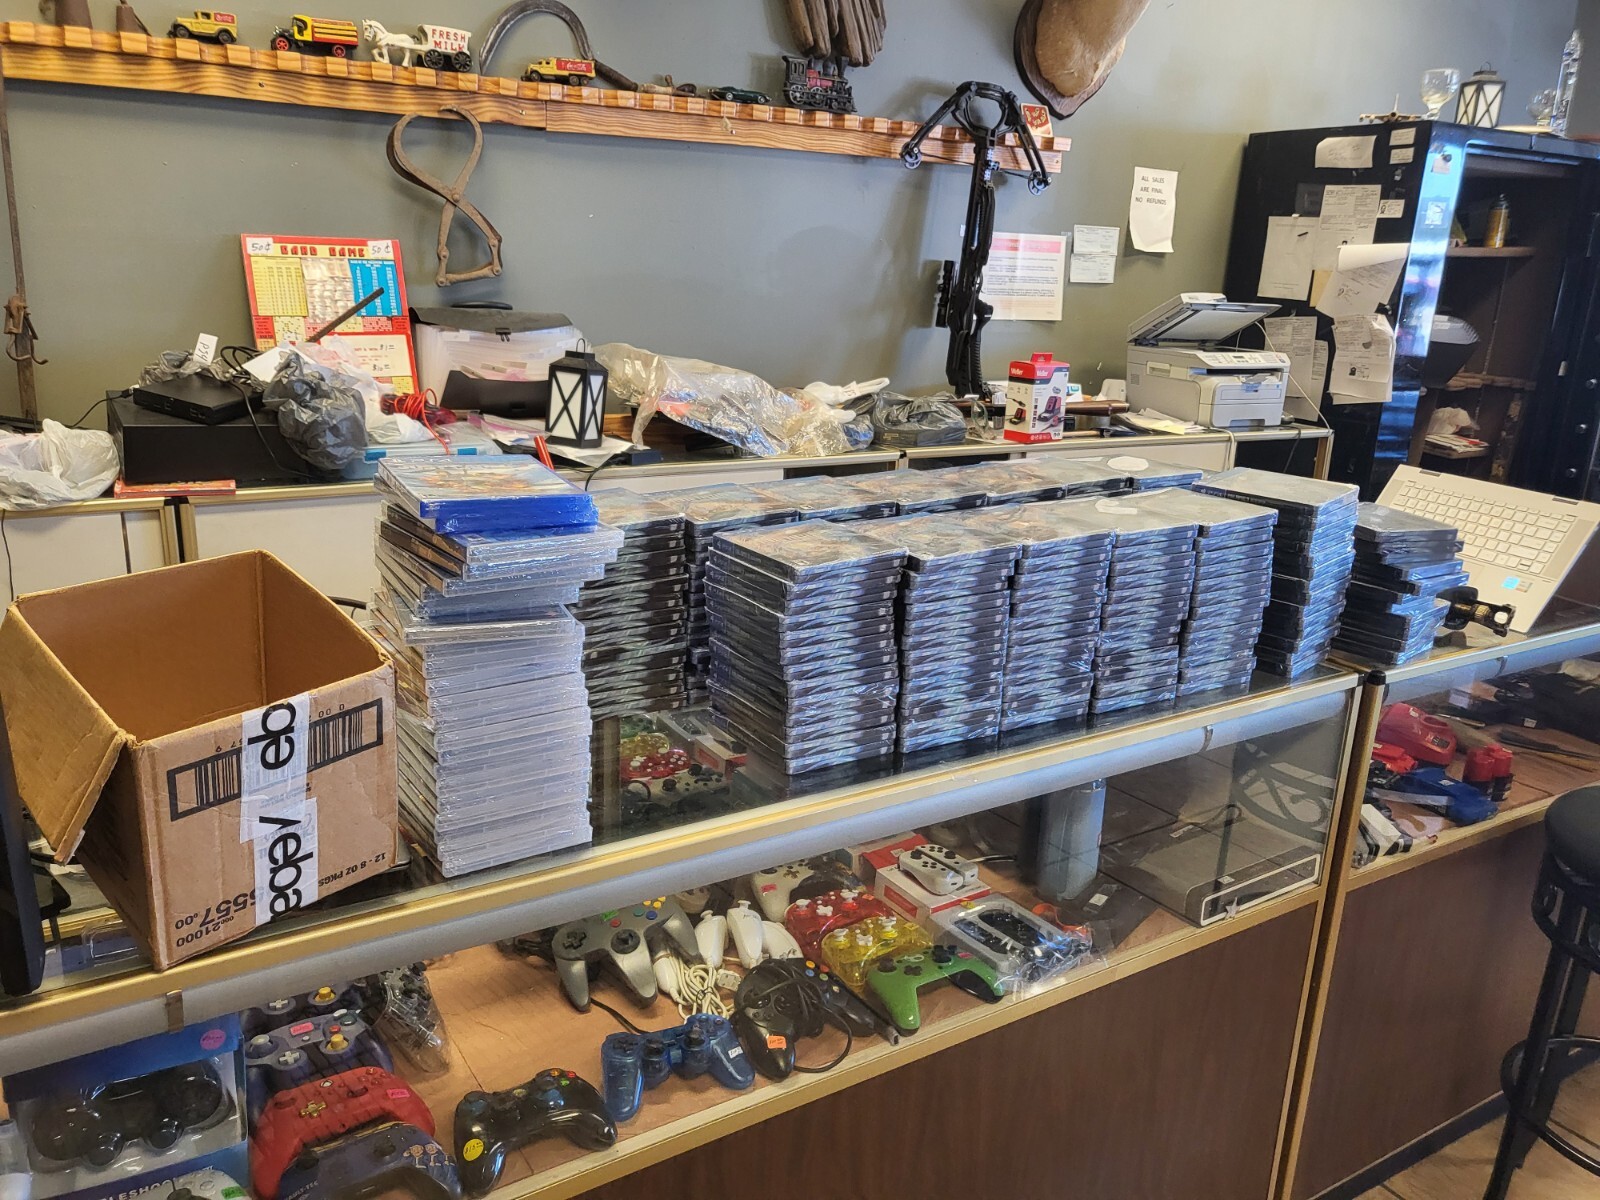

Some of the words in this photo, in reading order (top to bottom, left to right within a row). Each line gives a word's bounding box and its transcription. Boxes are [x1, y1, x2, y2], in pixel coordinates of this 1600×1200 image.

[431, 28, 466, 43] FRESH
[433, 39, 465, 52] MILK
[1151, 187, 1164, 195] FINAL
[1146, 197, 1167, 206] REFUNDS
[280, 244, 318, 256] CARD
[329, 246, 365, 257] GAME
[374, 852, 386, 863] 12
[345, 864, 359, 876] OZ
[360, 860, 367, 869] 8
[318, 870, 343, 887] PKGS
